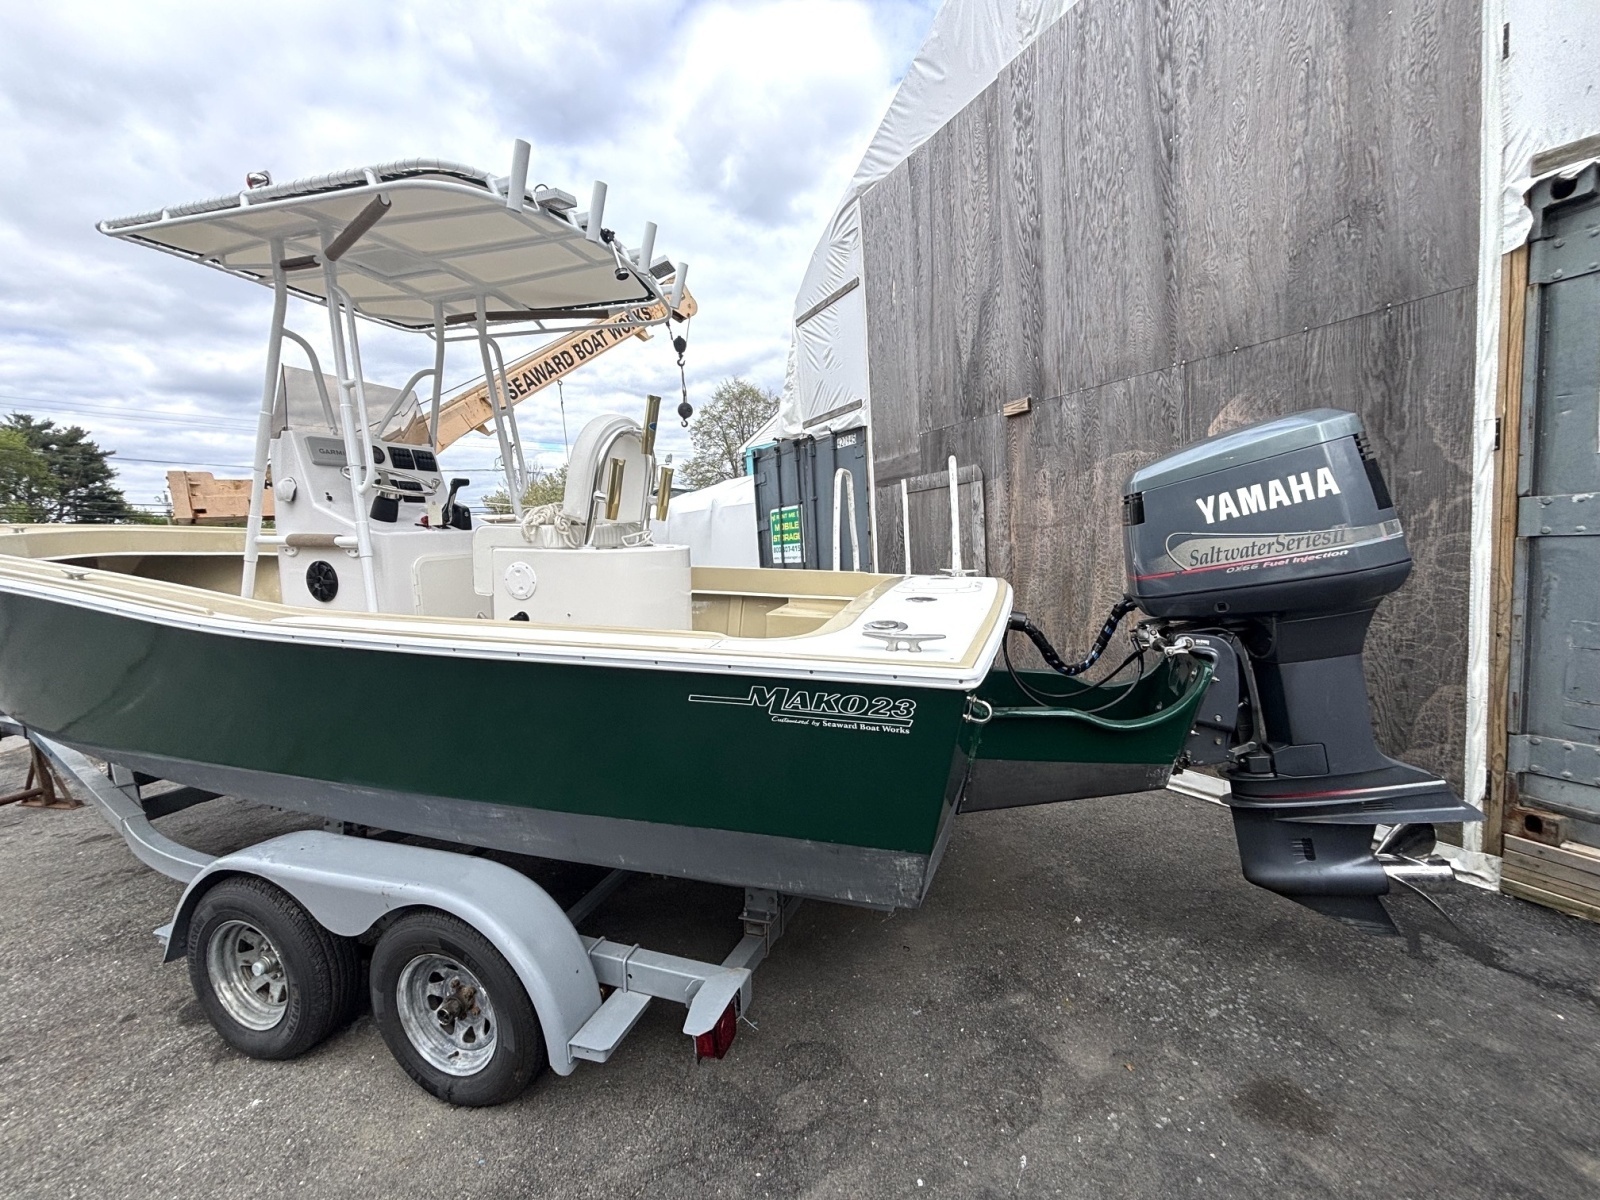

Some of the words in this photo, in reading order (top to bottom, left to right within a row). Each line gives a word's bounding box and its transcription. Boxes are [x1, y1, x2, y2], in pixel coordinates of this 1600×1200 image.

[507, 350, 575, 400] SEAWARD
[571, 329, 610, 361] BOAT
[1195, 466, 1342, 524] YAMAHA
[1226, 563, 1259, 574] OX66
[1262, 558, 1290, 568] Fuel
[1292, 549, 1350, 565] Injection
[822, 720, 858, 730] Seaward
[859, 723, 880, 732] Boat
[882, 725, 910, 734] Works
